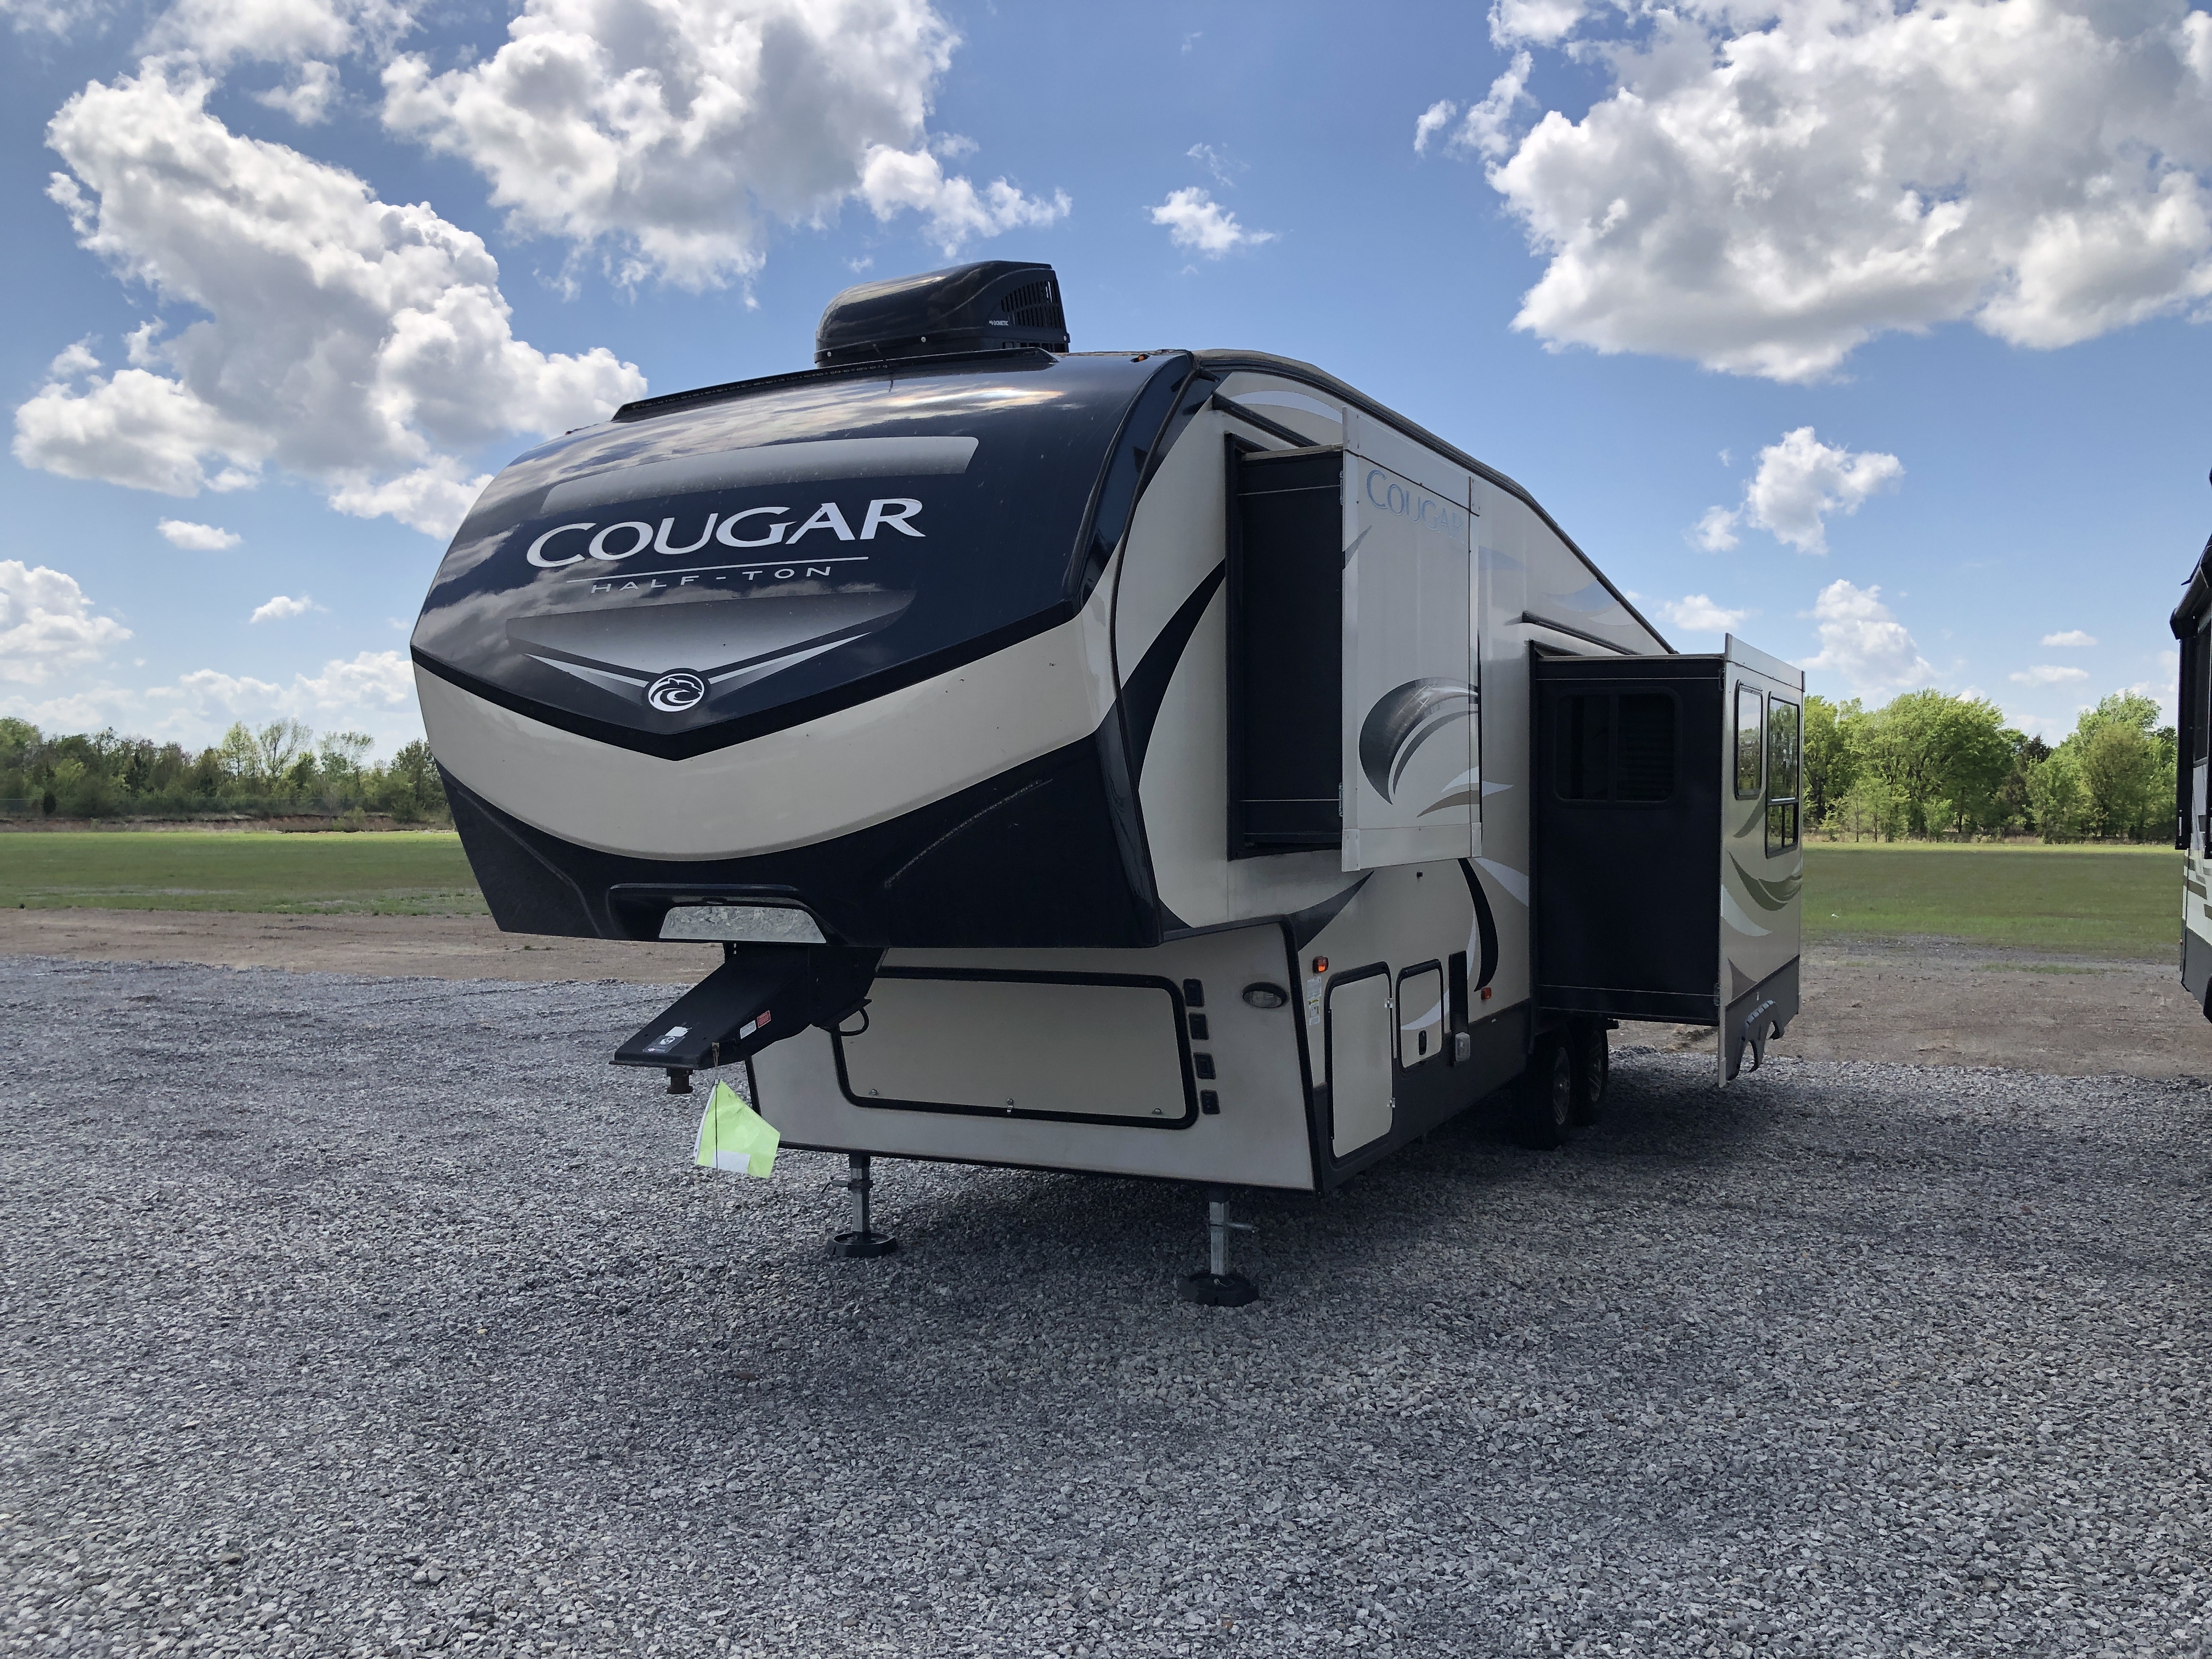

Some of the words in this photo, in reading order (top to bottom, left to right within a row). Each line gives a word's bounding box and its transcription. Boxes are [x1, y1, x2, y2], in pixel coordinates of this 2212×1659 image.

[526, 498, 926, 567] COUGAR
[1367, 469, 1465, 544] COUGAR
[591, 566, 831, 594] HALF-TON
